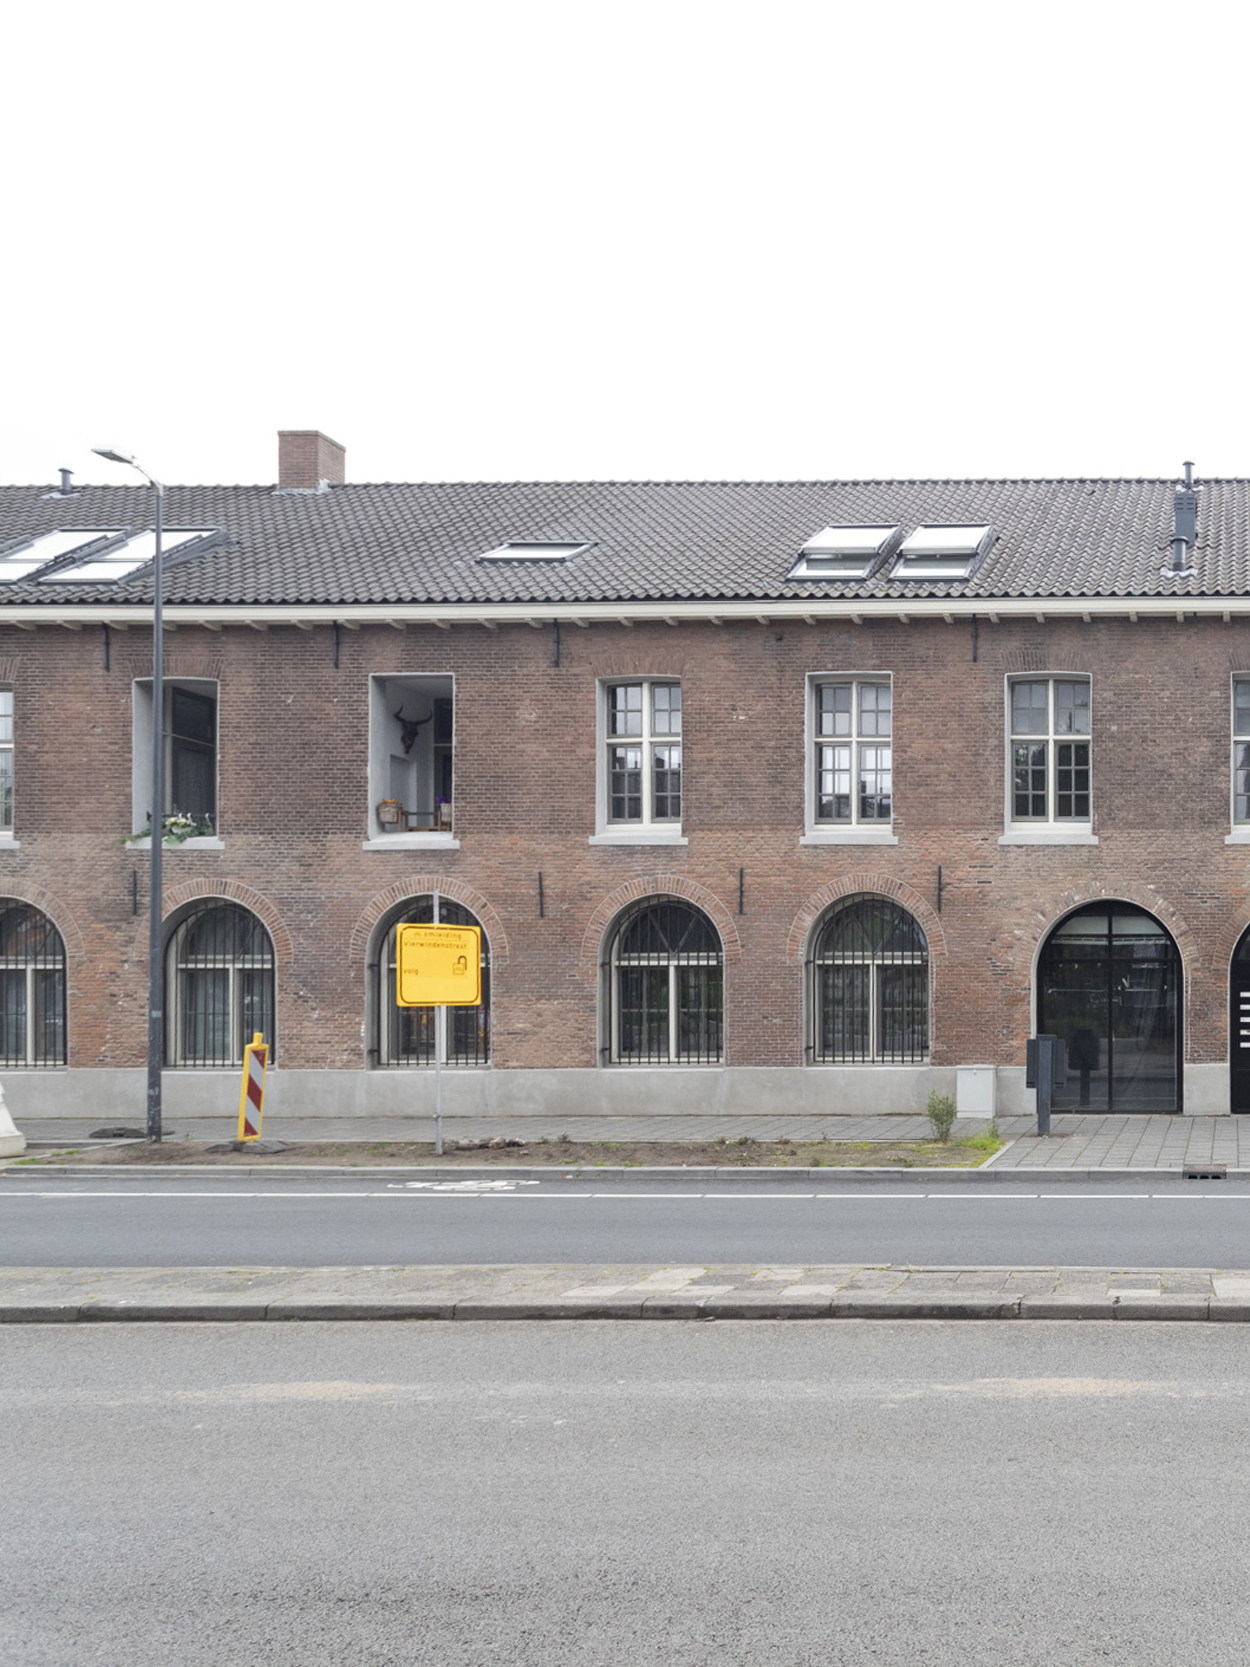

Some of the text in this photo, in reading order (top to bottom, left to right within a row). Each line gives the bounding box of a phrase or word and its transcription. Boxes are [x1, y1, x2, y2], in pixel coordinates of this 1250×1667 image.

[424, 931, 462, 940] omleiding
[403, 941, 467, 949] Vierwindenstraat
[403, 967, 419, 976] volg
